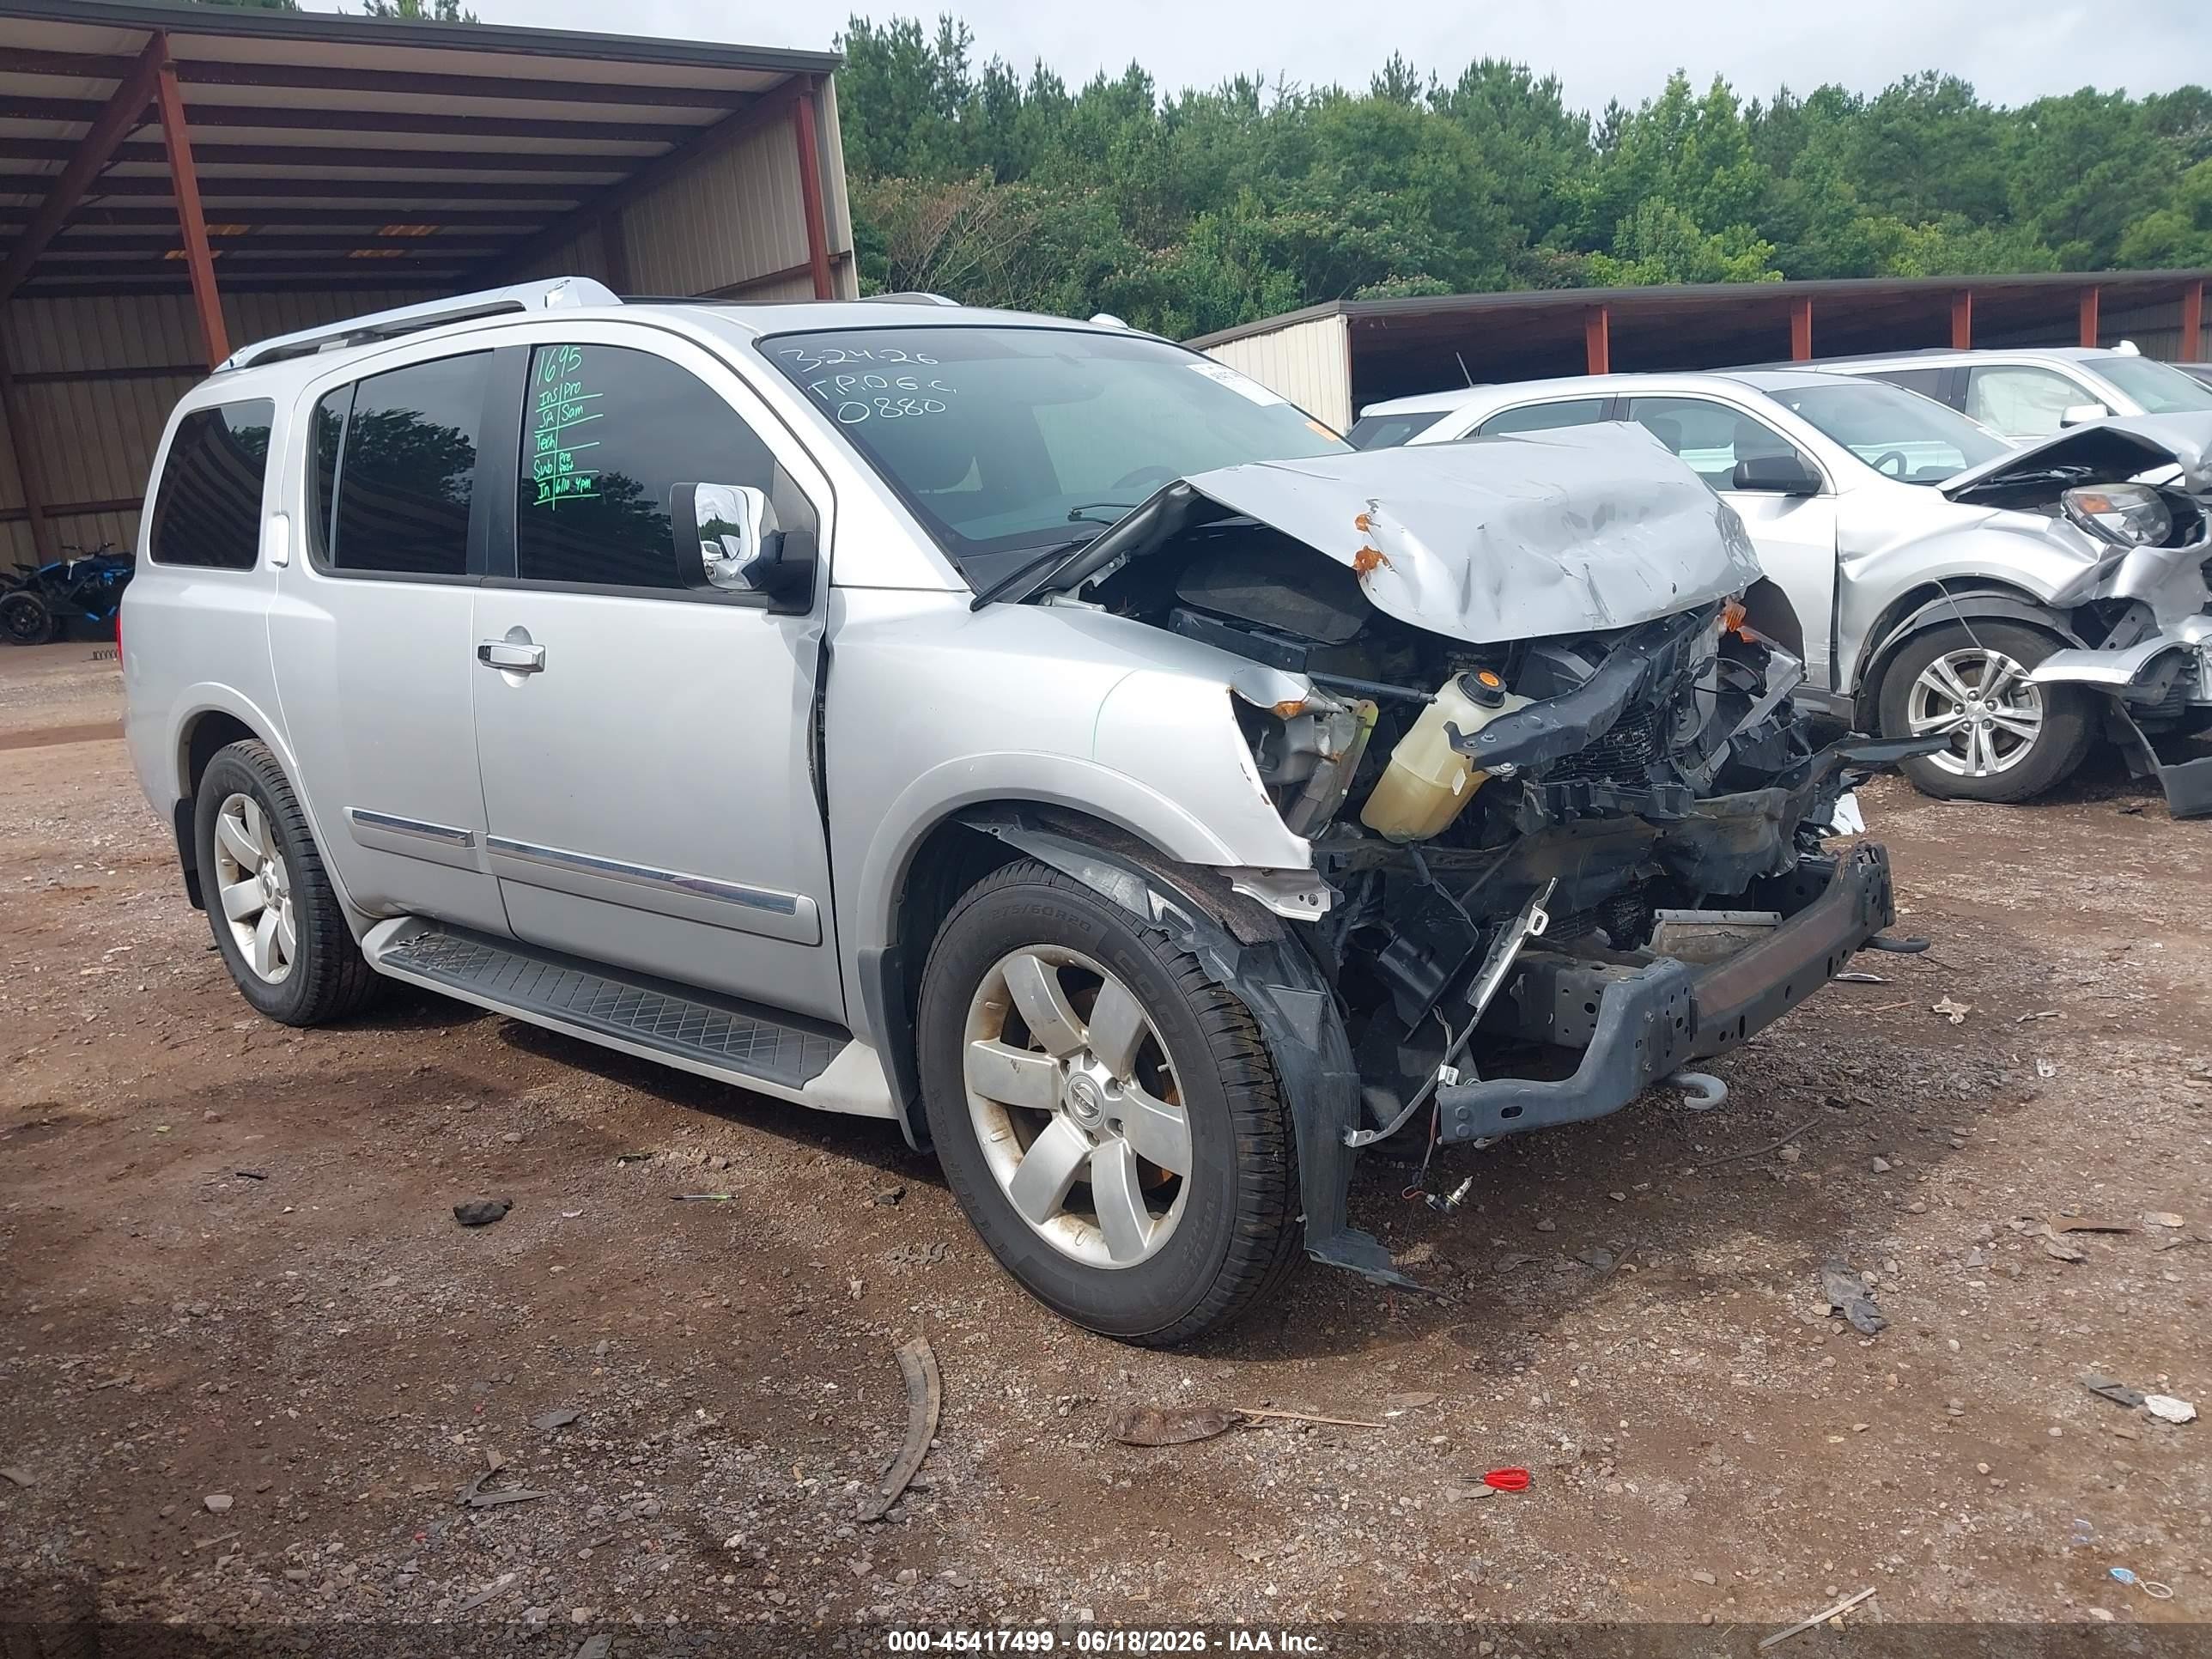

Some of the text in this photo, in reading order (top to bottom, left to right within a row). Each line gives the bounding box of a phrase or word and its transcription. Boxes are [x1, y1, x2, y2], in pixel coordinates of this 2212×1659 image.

[537, 345, 582, 386] 1695
[539, 387, 558, 407] Ins
[562, 404, 584, 421] Sam
[837, 398, 946, 423] 0880
[535, 434, 556, 452] Tech
[534, 459, 553, 480] Sub
[538, 483, 550, 499] In
